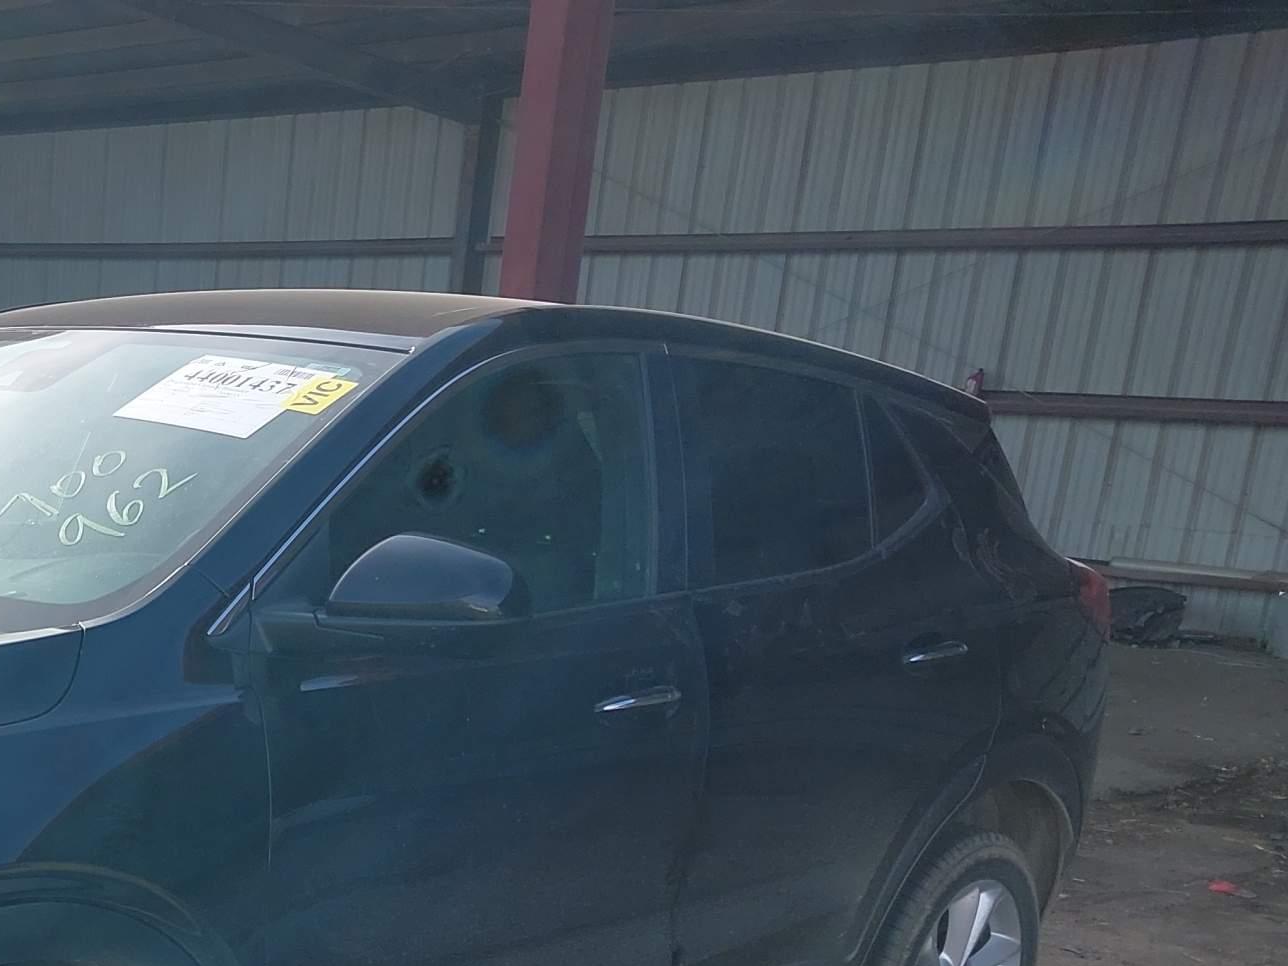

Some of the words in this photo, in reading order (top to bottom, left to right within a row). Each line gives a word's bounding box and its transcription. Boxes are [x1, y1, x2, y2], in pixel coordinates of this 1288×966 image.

[183, 369, 298, 395] 44001437
[290, 380, 343, 407] VIC
[58, 468, 199, 546] 962
